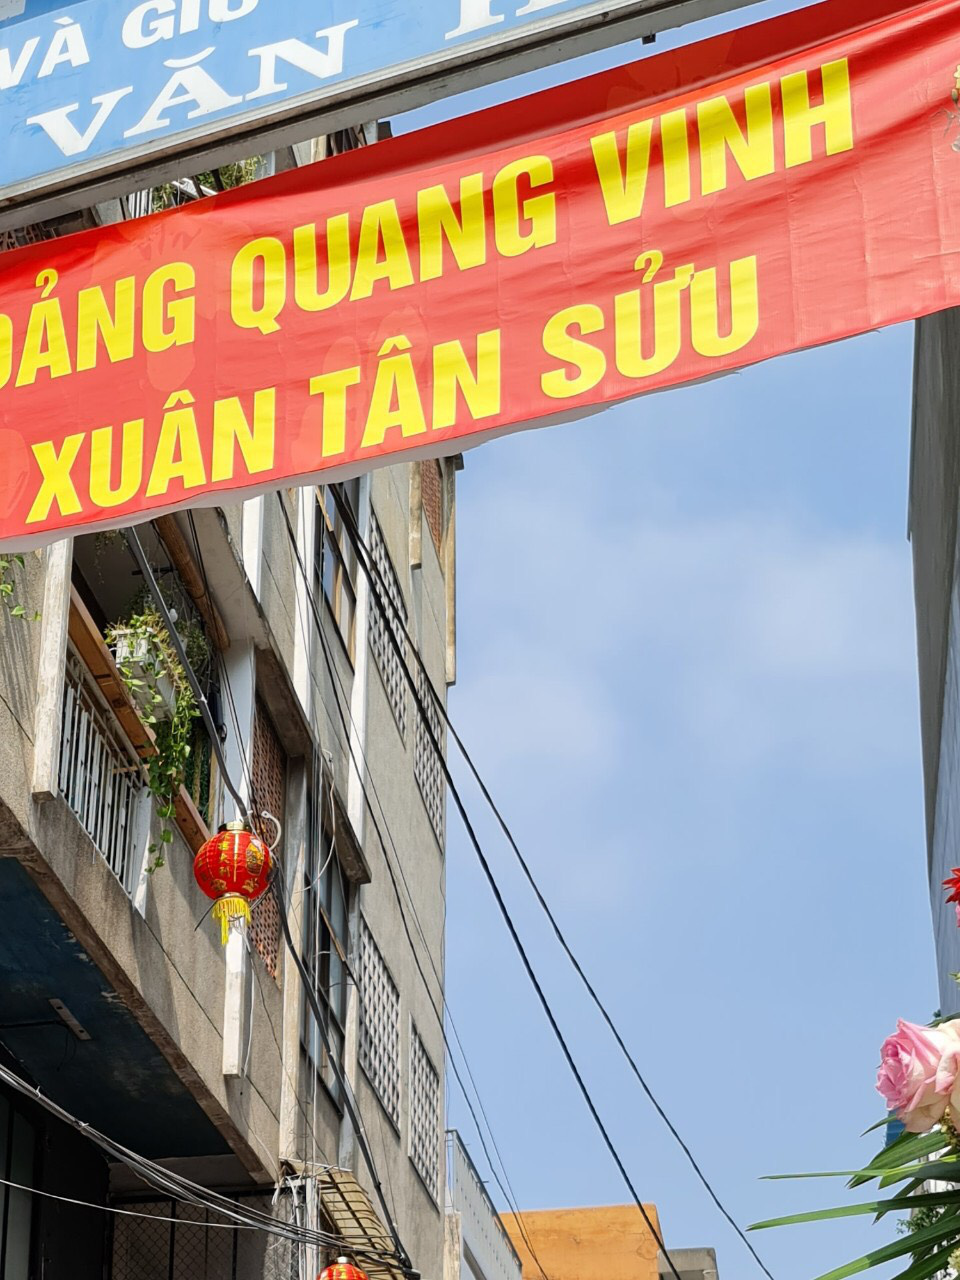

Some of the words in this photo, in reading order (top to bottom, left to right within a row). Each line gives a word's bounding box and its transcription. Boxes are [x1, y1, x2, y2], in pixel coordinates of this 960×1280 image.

[26, 19, 359, 157] VĂN
[230, 154, 558, 335] QUANG
[590, 57, 855, 226] VINH
[26, 386, 277, 524] XUÂN
[310, 329, 501, 458] TÂN
[540, 249, 760, 399] SỬU
